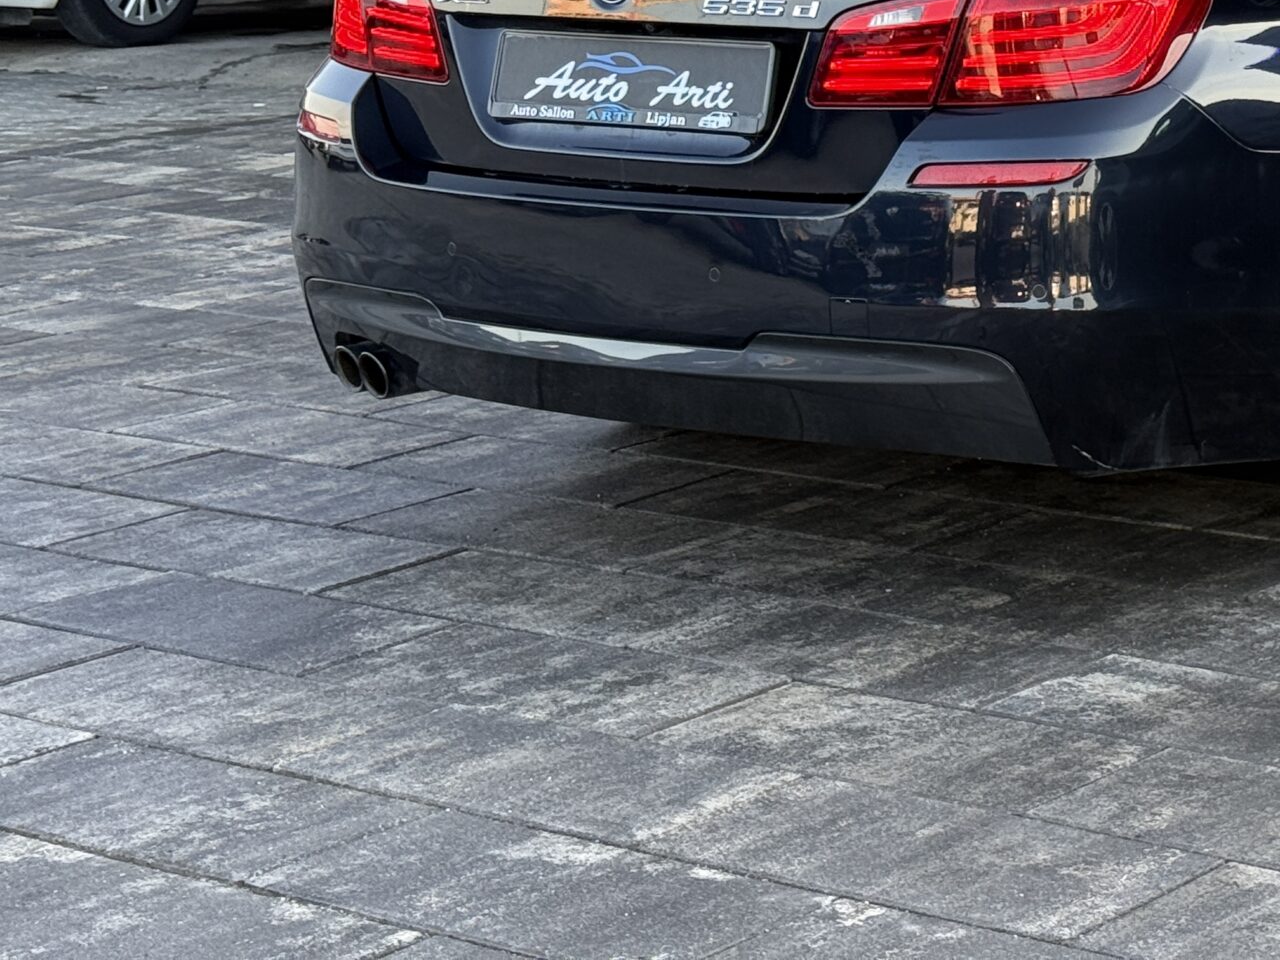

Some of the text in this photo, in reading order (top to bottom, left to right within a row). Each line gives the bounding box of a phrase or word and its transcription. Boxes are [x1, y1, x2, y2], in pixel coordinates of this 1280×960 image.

[523, 60, 734, 109] Auto Arti
[510, 104, 686, 127] Auto Sallon ARTI Lipjan
